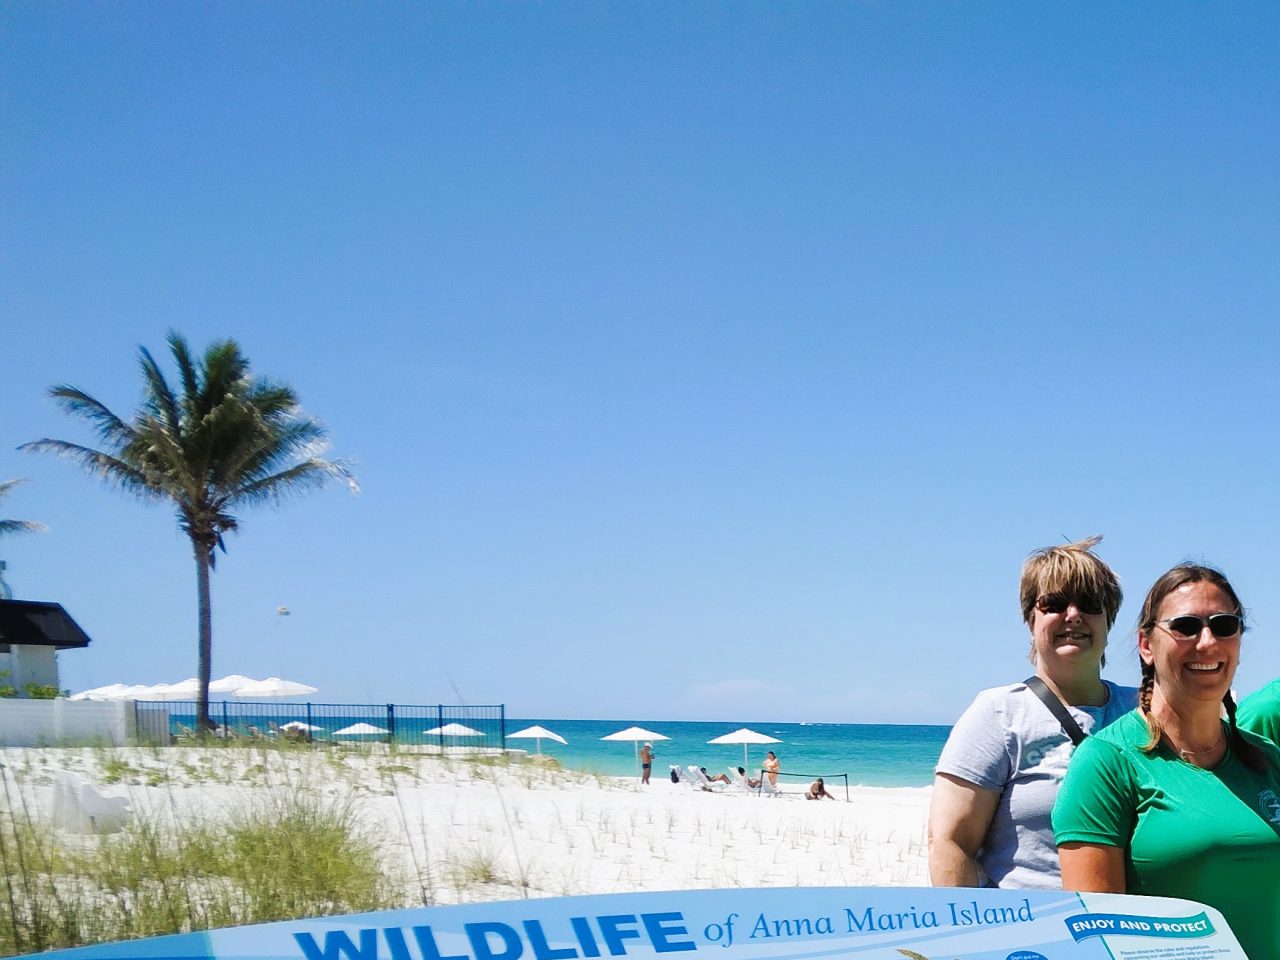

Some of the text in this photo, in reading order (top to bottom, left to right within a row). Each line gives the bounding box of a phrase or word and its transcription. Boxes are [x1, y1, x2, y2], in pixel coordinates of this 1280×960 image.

[704, 913, 739, 948] of
[749, 912, 835, 939] Anna
[844, 906, 939, 933] Maria
[947, 899, 1036, 926] Island
[1072, 919, 1208, 933] ENJOY AND PROTECT
